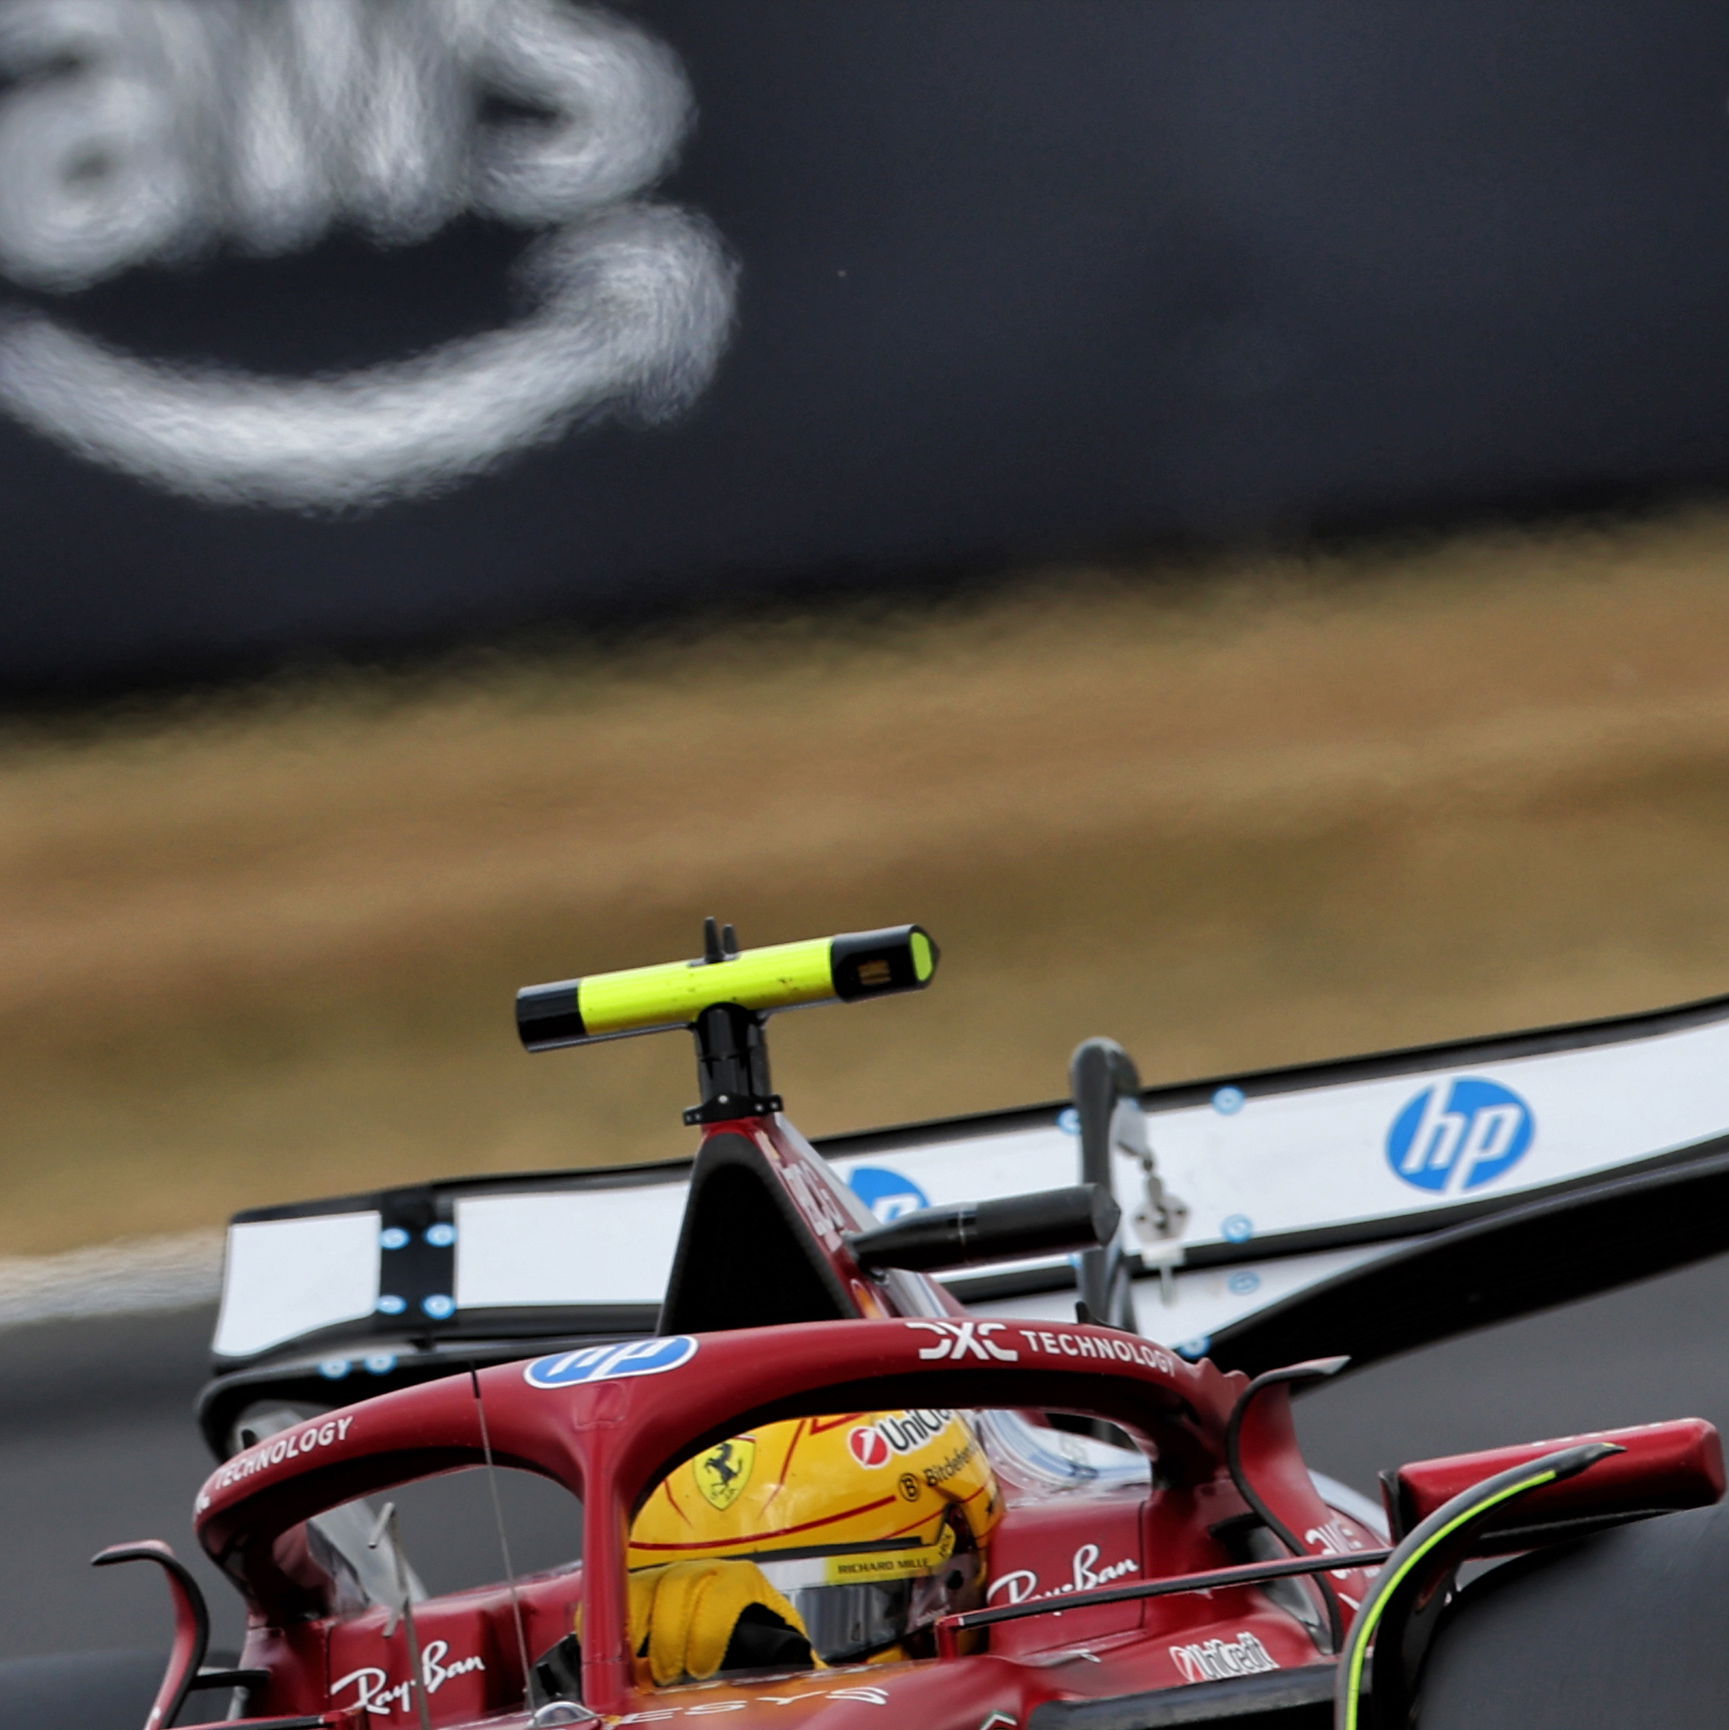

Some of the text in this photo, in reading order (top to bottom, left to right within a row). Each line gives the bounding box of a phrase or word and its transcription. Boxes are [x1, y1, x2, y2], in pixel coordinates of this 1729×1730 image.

[1396, 1077, 1528, 1192] hp
[906, 1322, 1018, 1361] DXC
[214, 1416, 354, 1490] TECHNOLOGY
